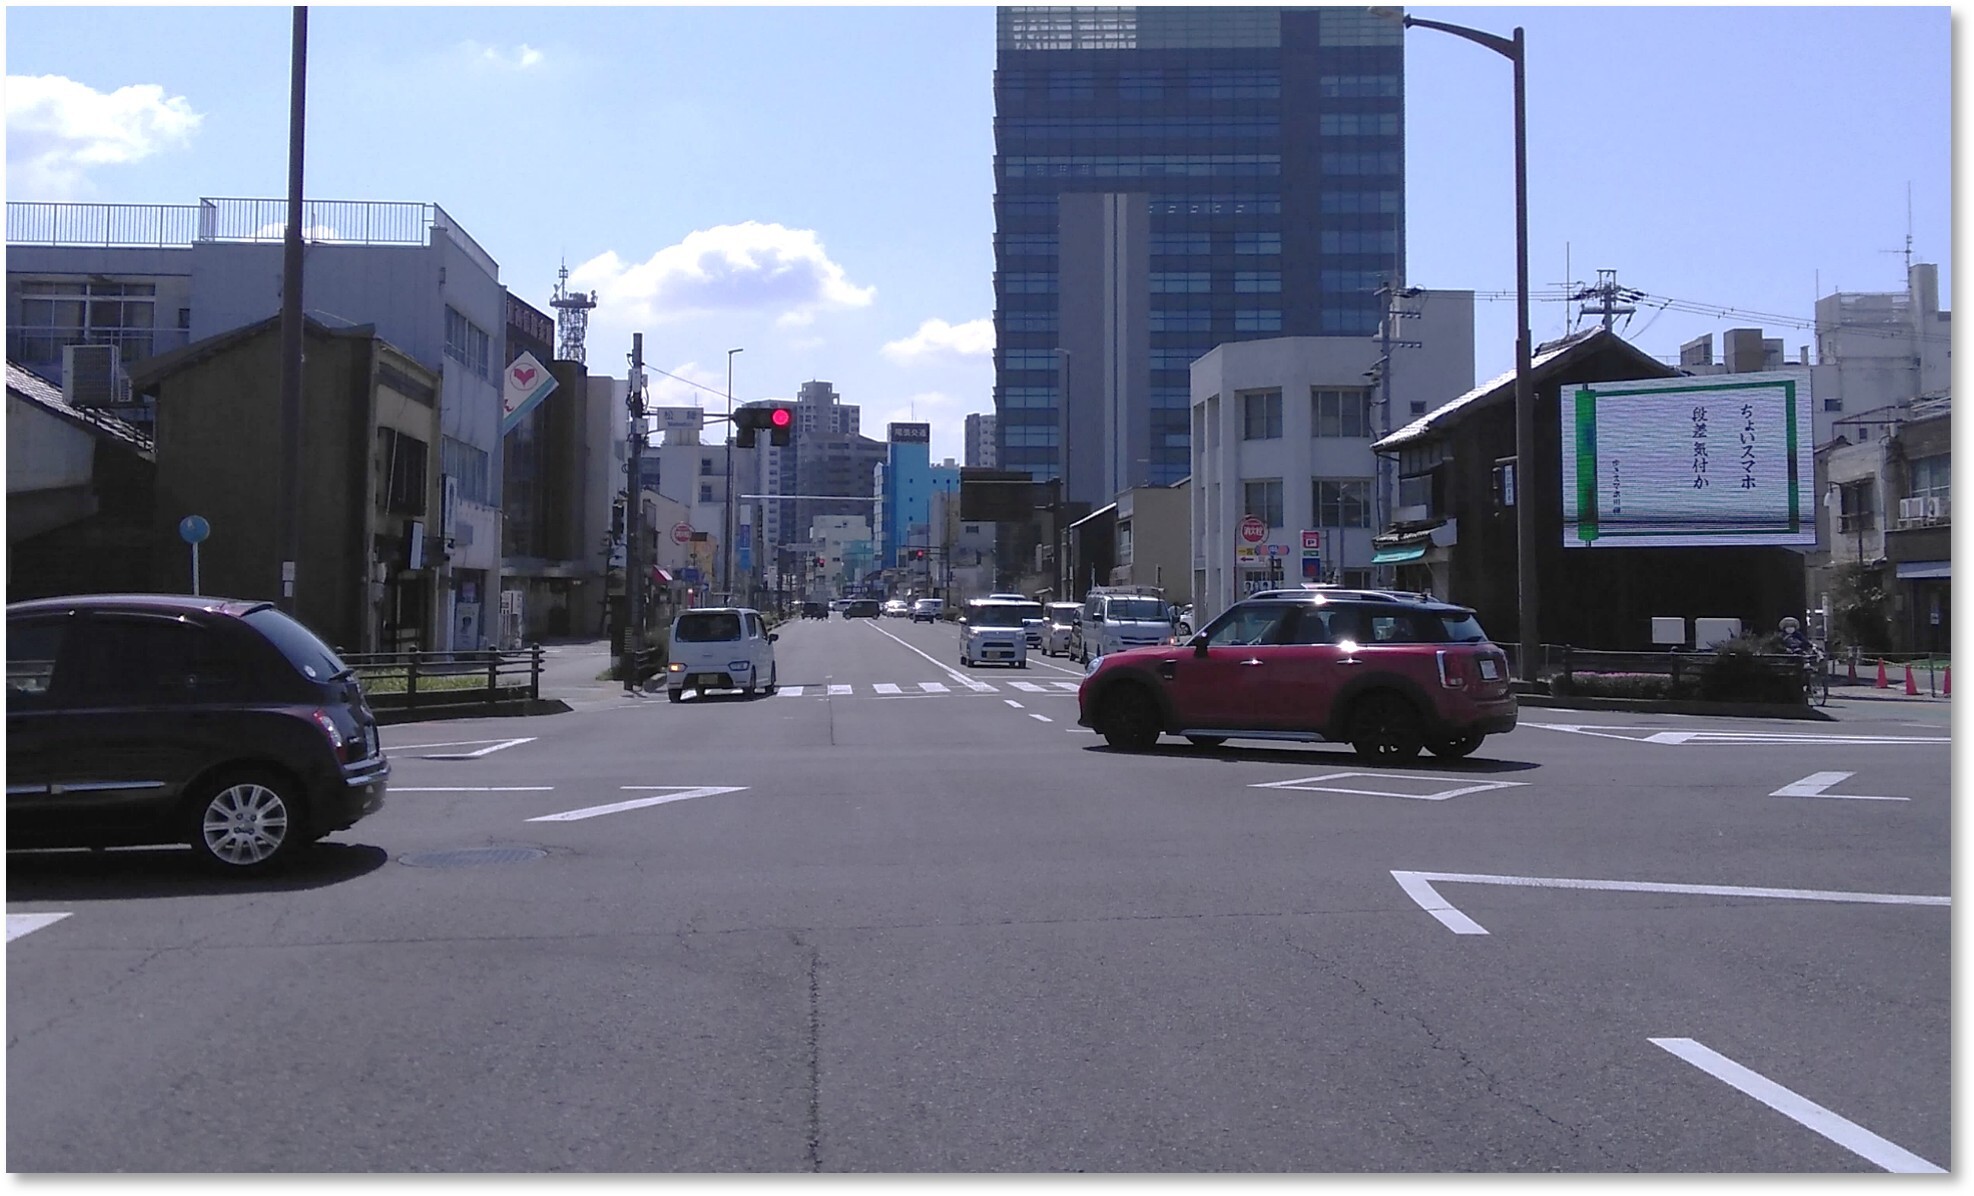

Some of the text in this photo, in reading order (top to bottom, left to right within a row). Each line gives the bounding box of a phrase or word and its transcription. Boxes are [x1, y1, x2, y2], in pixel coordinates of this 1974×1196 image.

[1692, 407, 1709, 489] 段差気付か
[1741, 404, 1756, 489] ちょいスマホ
